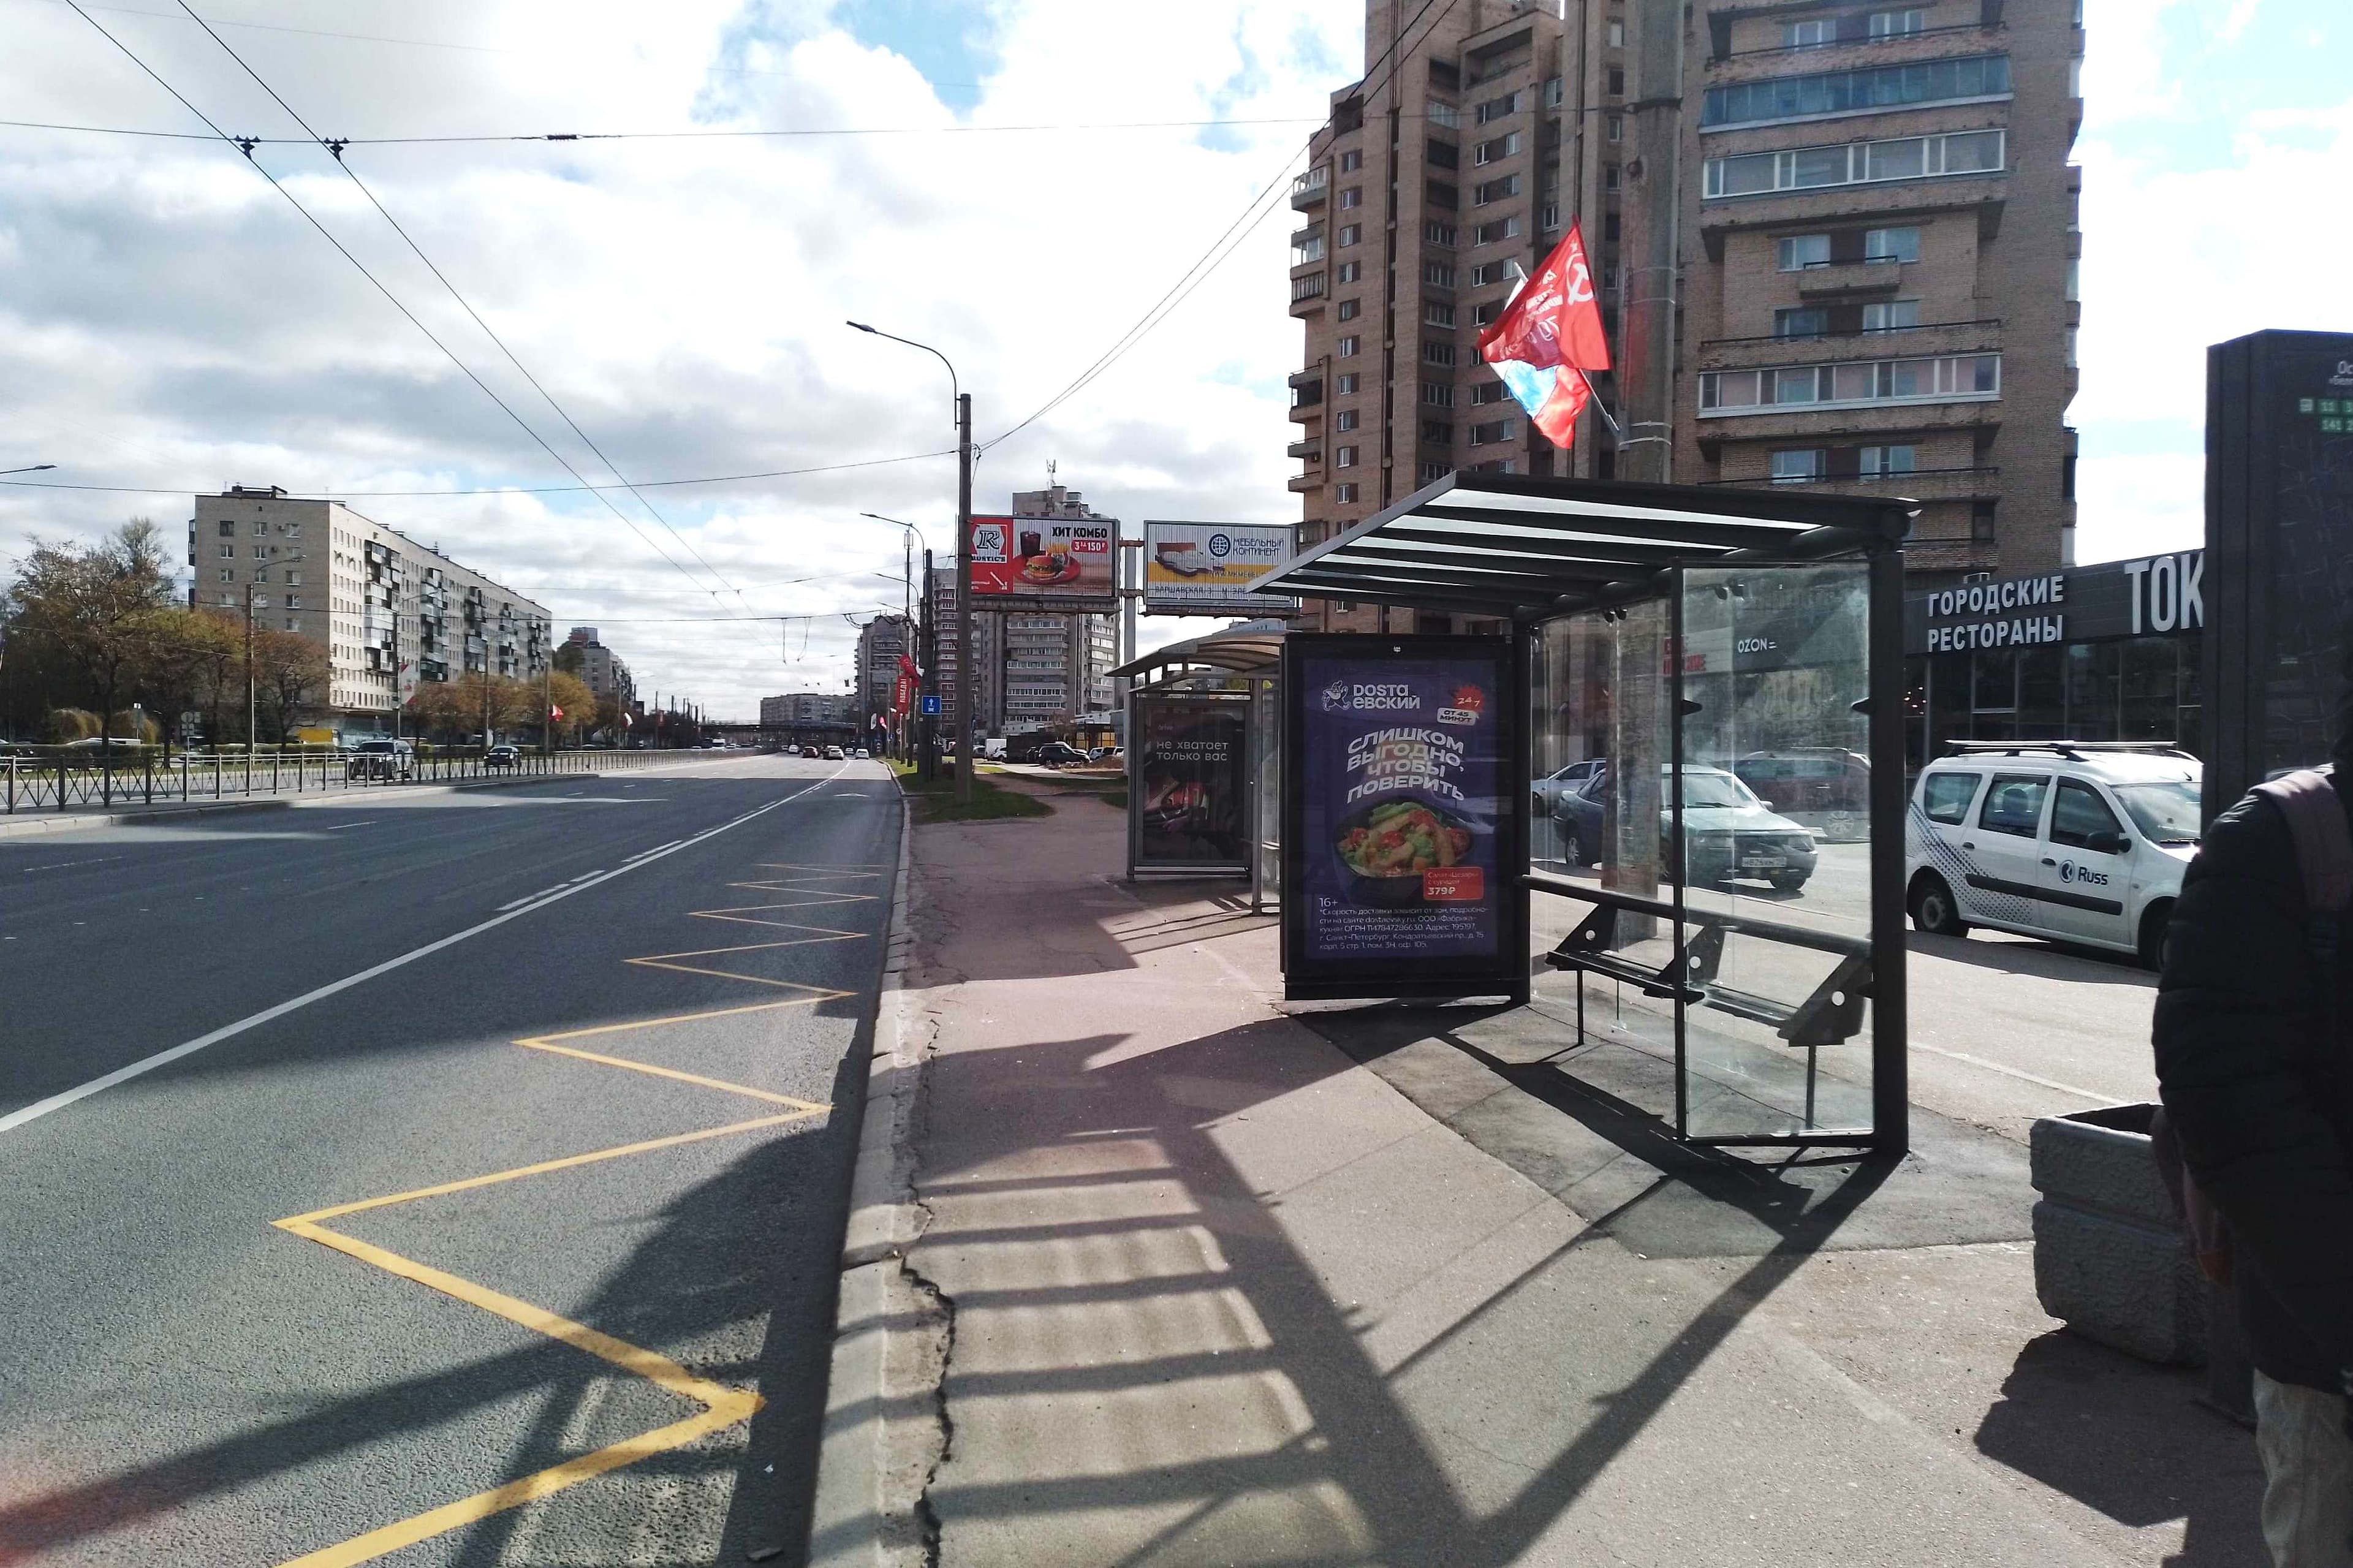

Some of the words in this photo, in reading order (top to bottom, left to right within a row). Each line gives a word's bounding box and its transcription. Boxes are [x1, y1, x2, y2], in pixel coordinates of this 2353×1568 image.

[1052, 527, 1072, 537] ХИТ
[1074, 527, 1107, 538] КОМБО
[1233, 538, 1284, 548] МЕБЕЛЬНЫЙ
[1928, 575, 2064, 617] ГОРОДСКИЕ
[1927, 615, 2063, 653] РЕСТОРАНЫ
[1176, 741, 1229, 750] хватает
[1347, 727, 1464, 754] СЛИШКОМ
[1156, 752, 1200, 760] только
[1347, 743, 1464, 773] ВЫГОДНО,
[1368, 759, 1446, 778] ЧТОБЫ
[1347, 775, 1464, 804] ПОВЕРИТЬ
[2078, 866, 2108, 885] Russ
[1319, 898, 1338, 907] 16+
